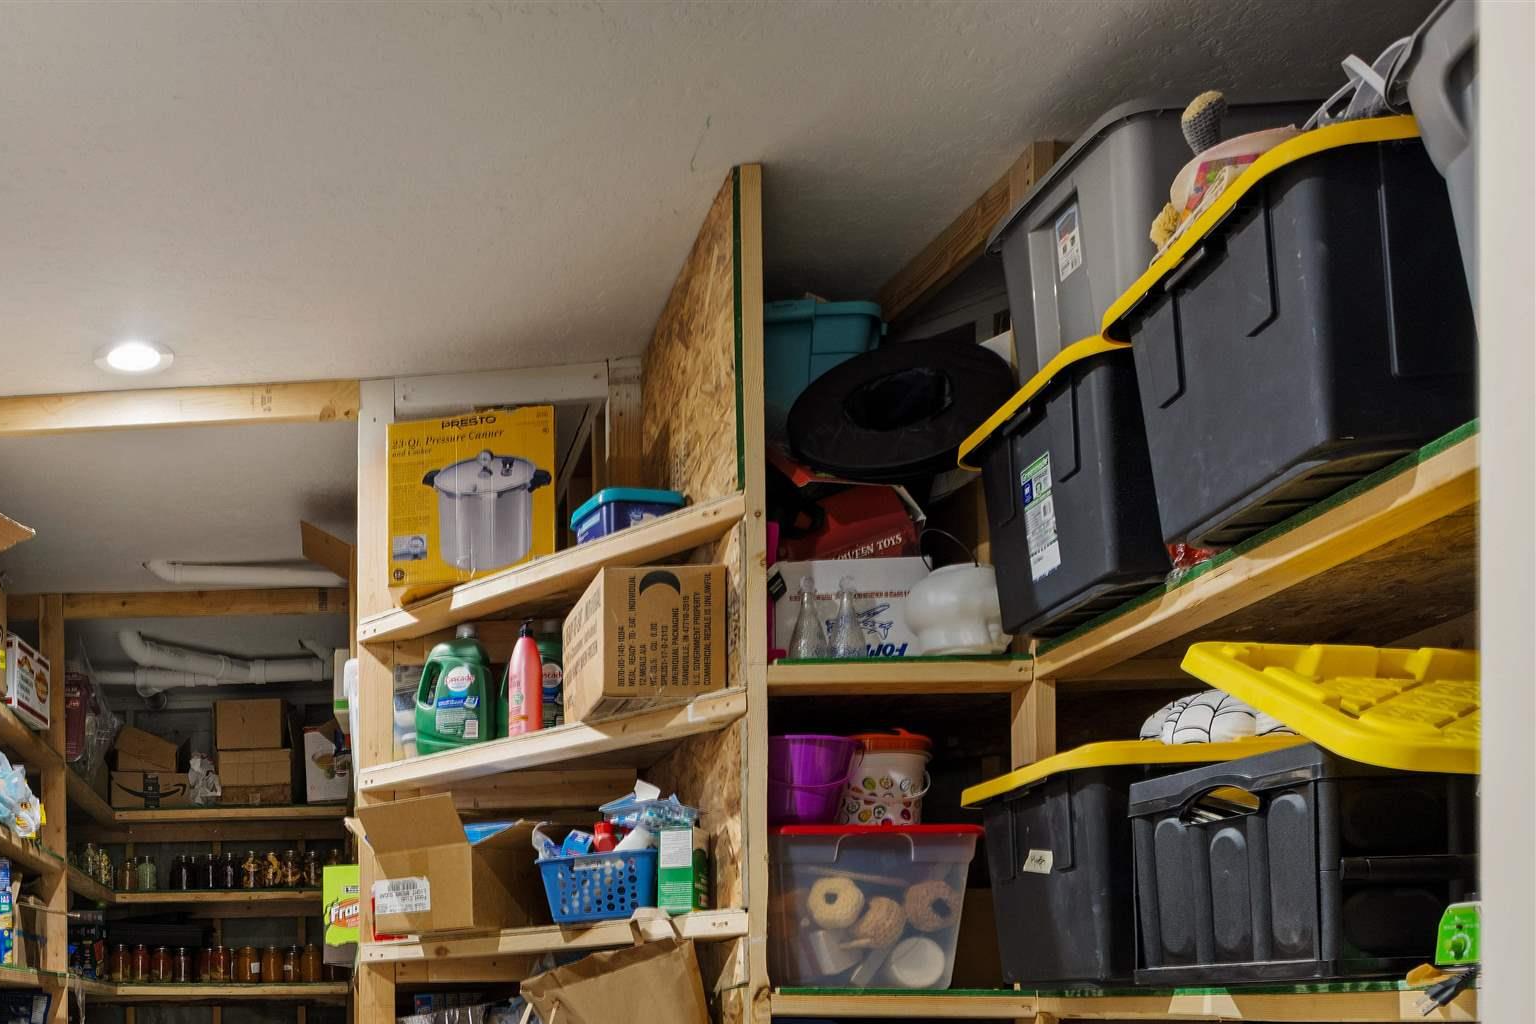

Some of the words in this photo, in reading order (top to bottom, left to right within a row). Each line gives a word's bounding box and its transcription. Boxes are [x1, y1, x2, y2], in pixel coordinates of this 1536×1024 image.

[441, 416, 497, 430] PRESTO
[876, 533, 902, 550] TOYS
[693, 592, 701, 630] PROPERTY
